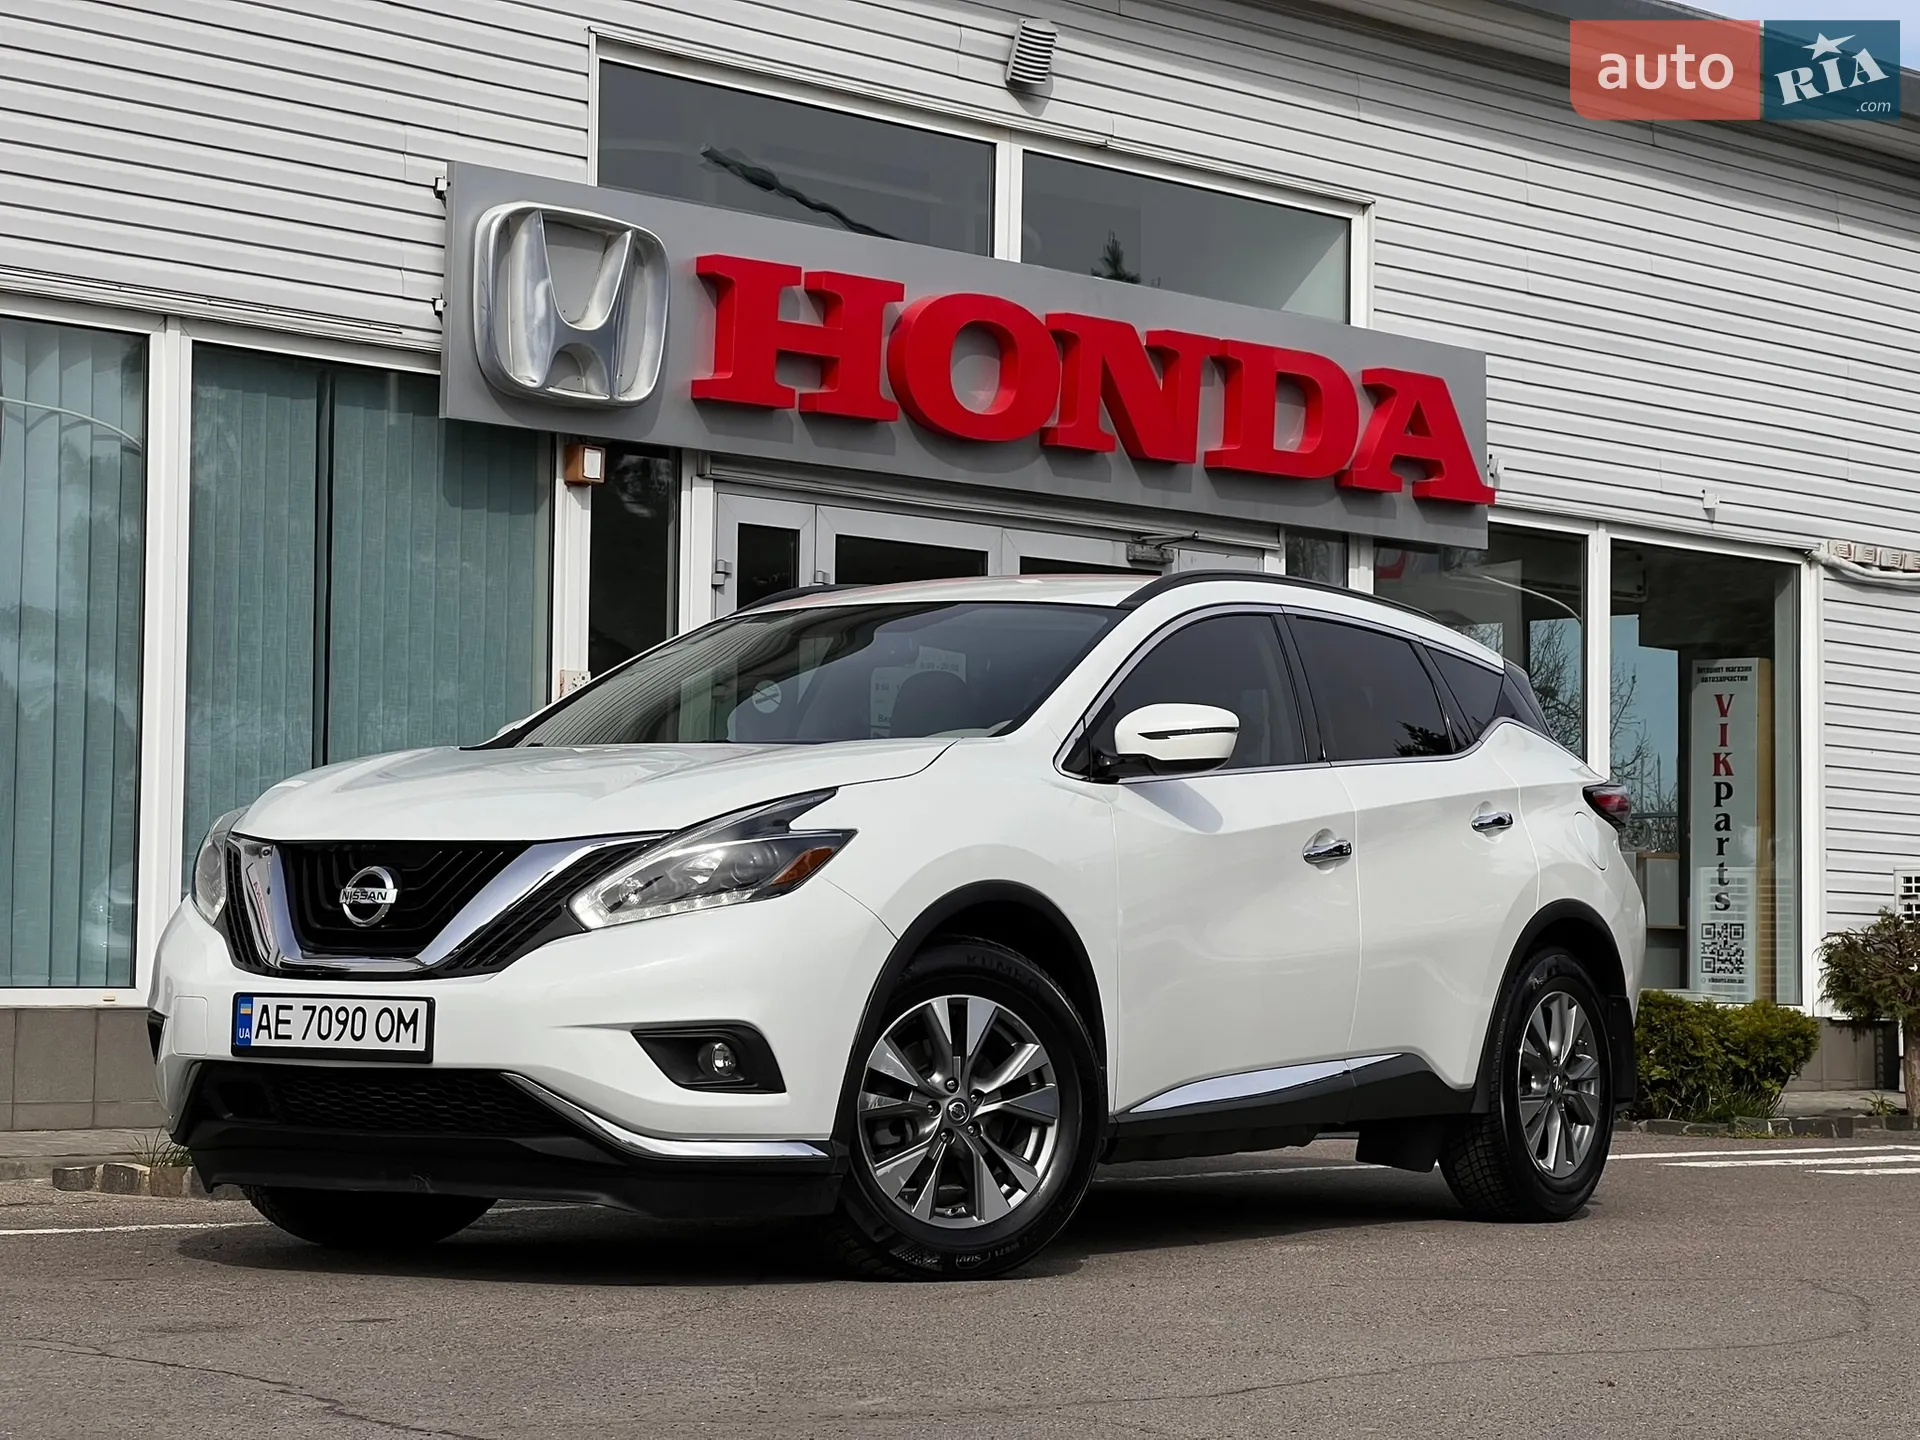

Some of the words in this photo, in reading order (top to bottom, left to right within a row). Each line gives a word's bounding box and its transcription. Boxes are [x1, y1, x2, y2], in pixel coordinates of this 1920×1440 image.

[691, 253, 1496, 505] HONDA
[341, 888, 388, 901] NISSAN
[238, 1027, 251, 1040] UA
[254, 1004, 294, 1041] AE
[301, 1004, 367, 1043] 7090
[375, 1006, 420, 1044] OM
